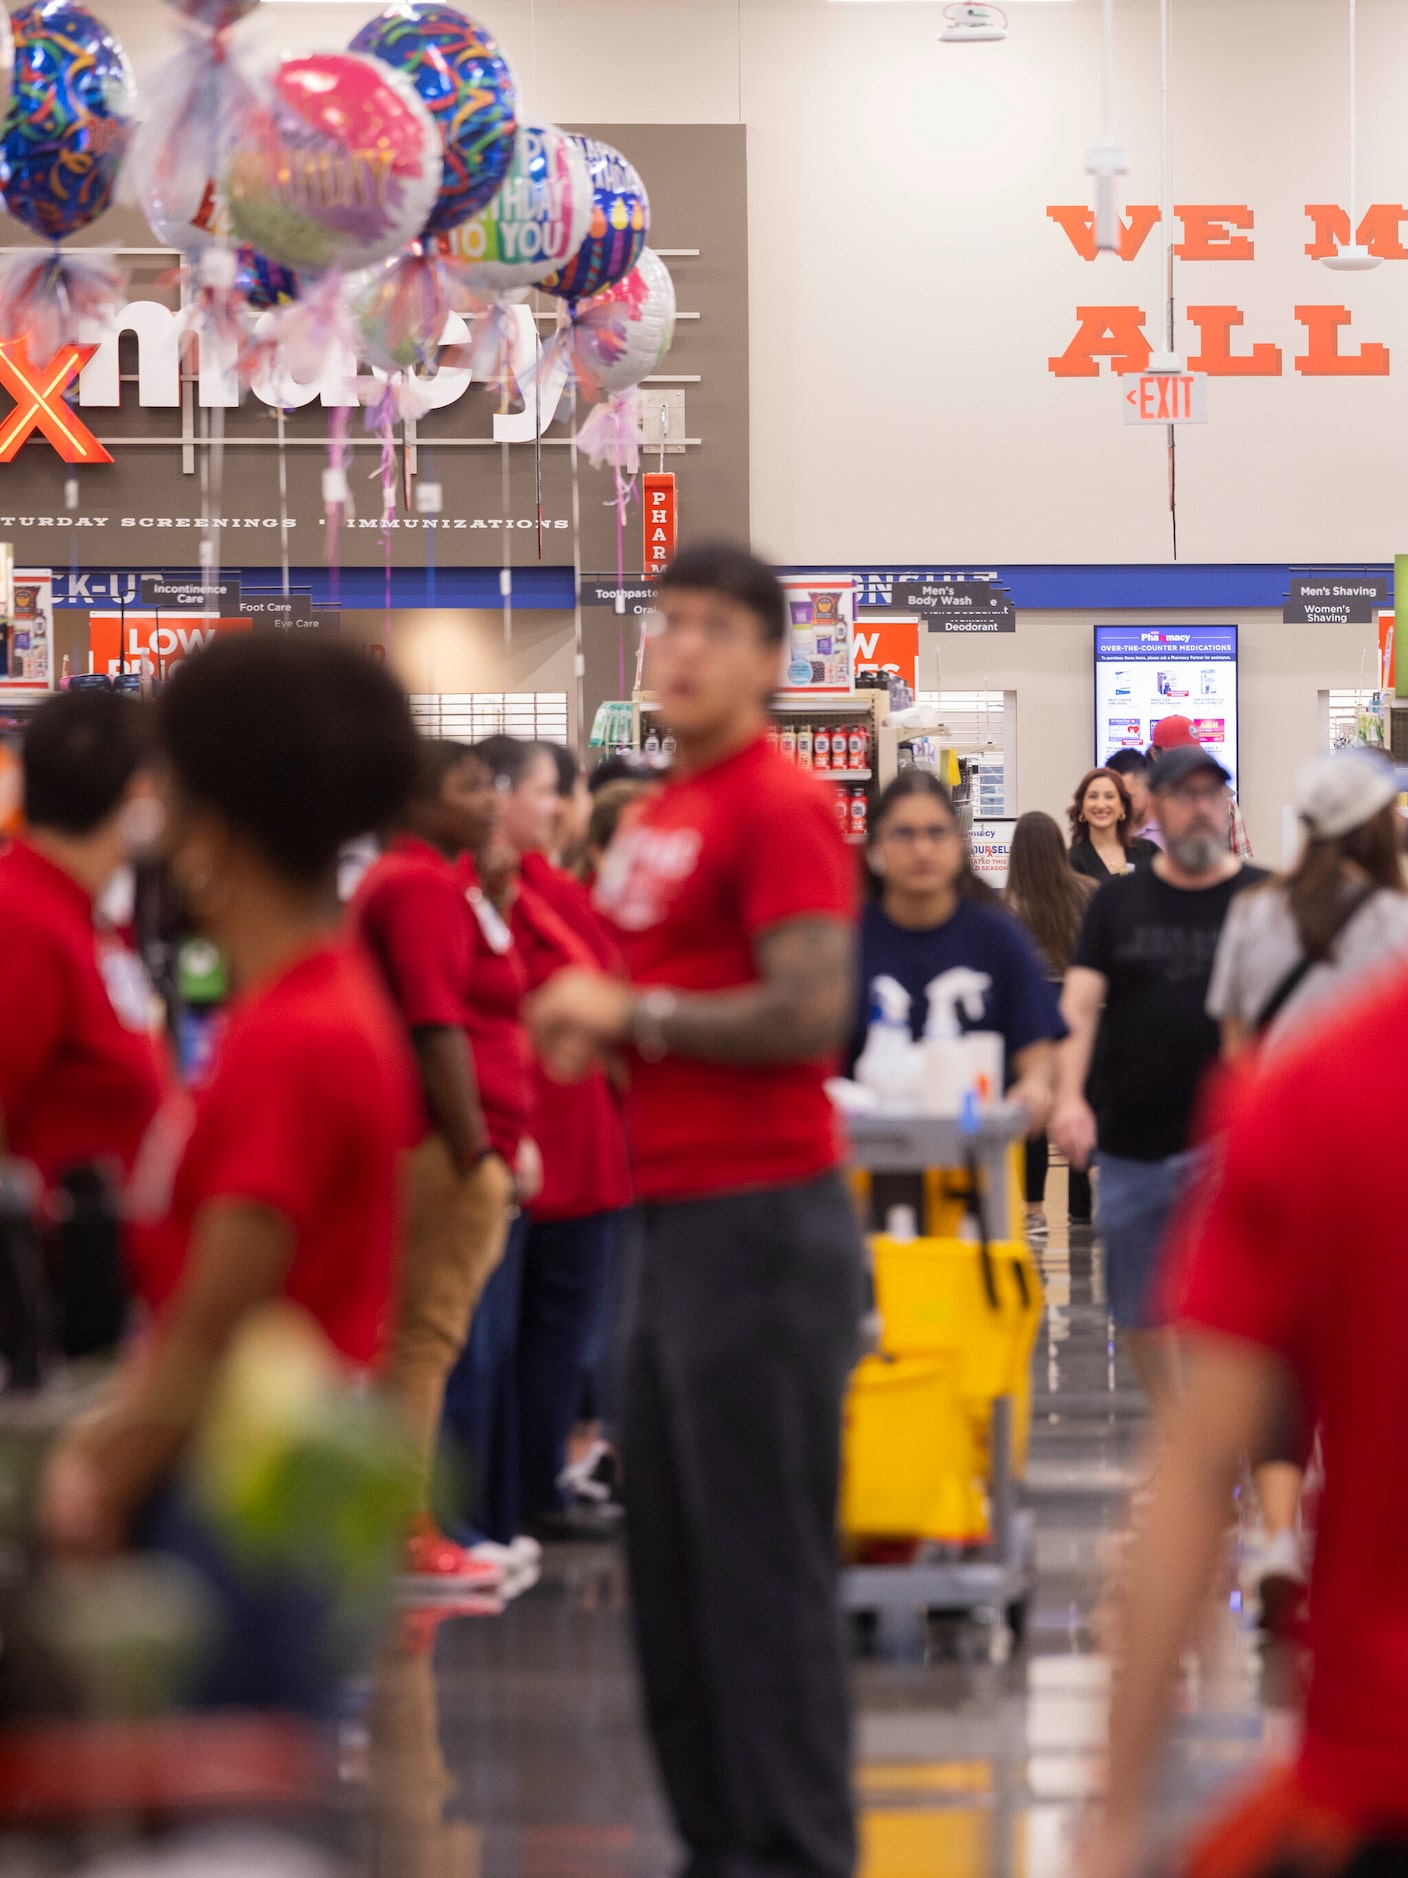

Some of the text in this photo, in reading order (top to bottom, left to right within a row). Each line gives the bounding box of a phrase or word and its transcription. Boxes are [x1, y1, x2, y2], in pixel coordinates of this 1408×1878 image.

[1046, 204, 1255, 262] WE
[500, 221, 565, 258] YOU
[1048, 304, 1390, 378] ALL
[1139, 376, 1195, 419] EXIT
[120, 517, 297, 528] SCREENINGS
[347, 518, 569, 529] IMMUNIZATIONS
[153, 583, 228, 595] Incontinence
[922, 586, 955, 596] Men's
[1300, 586, 1377, 598] Men's Shaving
[176, 594, 205, 604] Care
[907, 595, 973, 607] Body Wash
[239, 602, 292, 613] Foot Care
[1304, 604, 1351, 614] Women's
[274, 619, 320, 629] Eye Care
[1307, 613, 1348, 624] Shaving
[945, 622, 998, 632] Deodorant
[128, 628, 216, 656] LOW
[1100, 644, 1232, 652] OVER-THE-COUNTER MEDICATIONS
